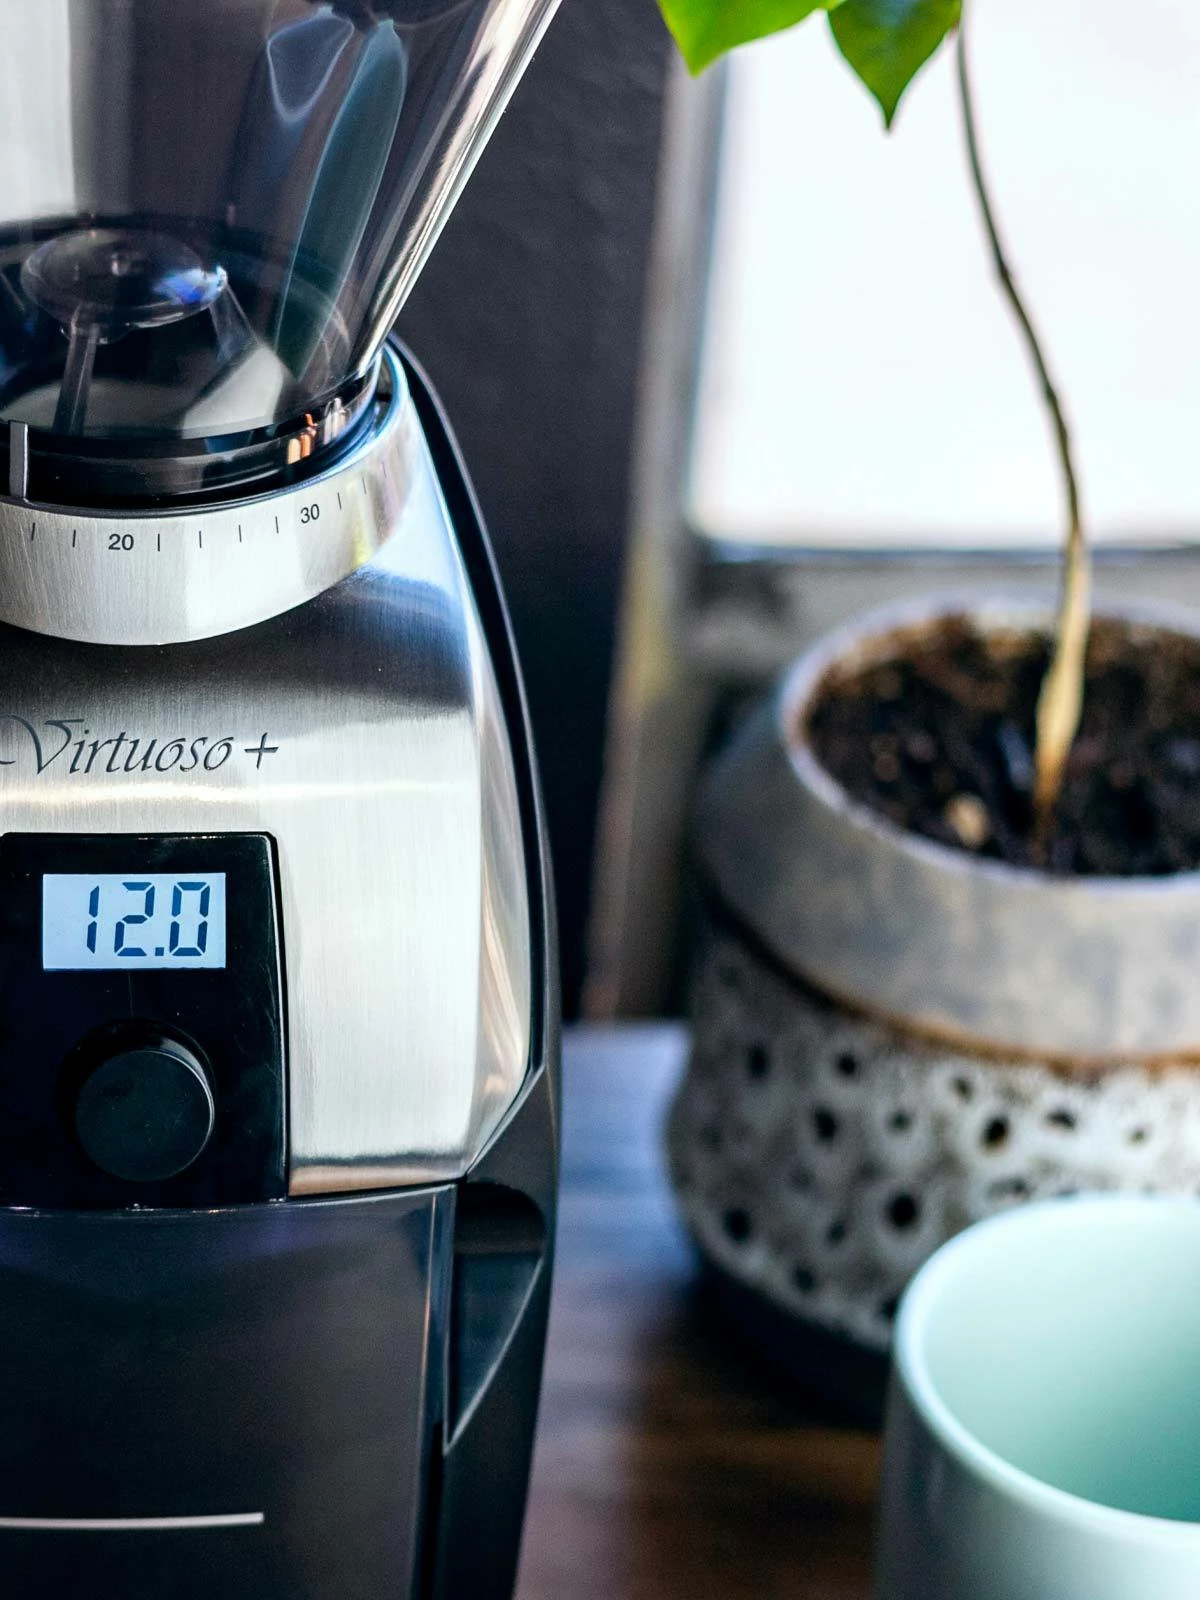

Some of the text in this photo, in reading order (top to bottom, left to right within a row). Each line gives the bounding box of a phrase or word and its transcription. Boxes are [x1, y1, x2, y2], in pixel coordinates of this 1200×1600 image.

[300, 503, 321, 524] 30
[107, 533, 135, 551] 20
[86, 881, 211, 957] 12.0
